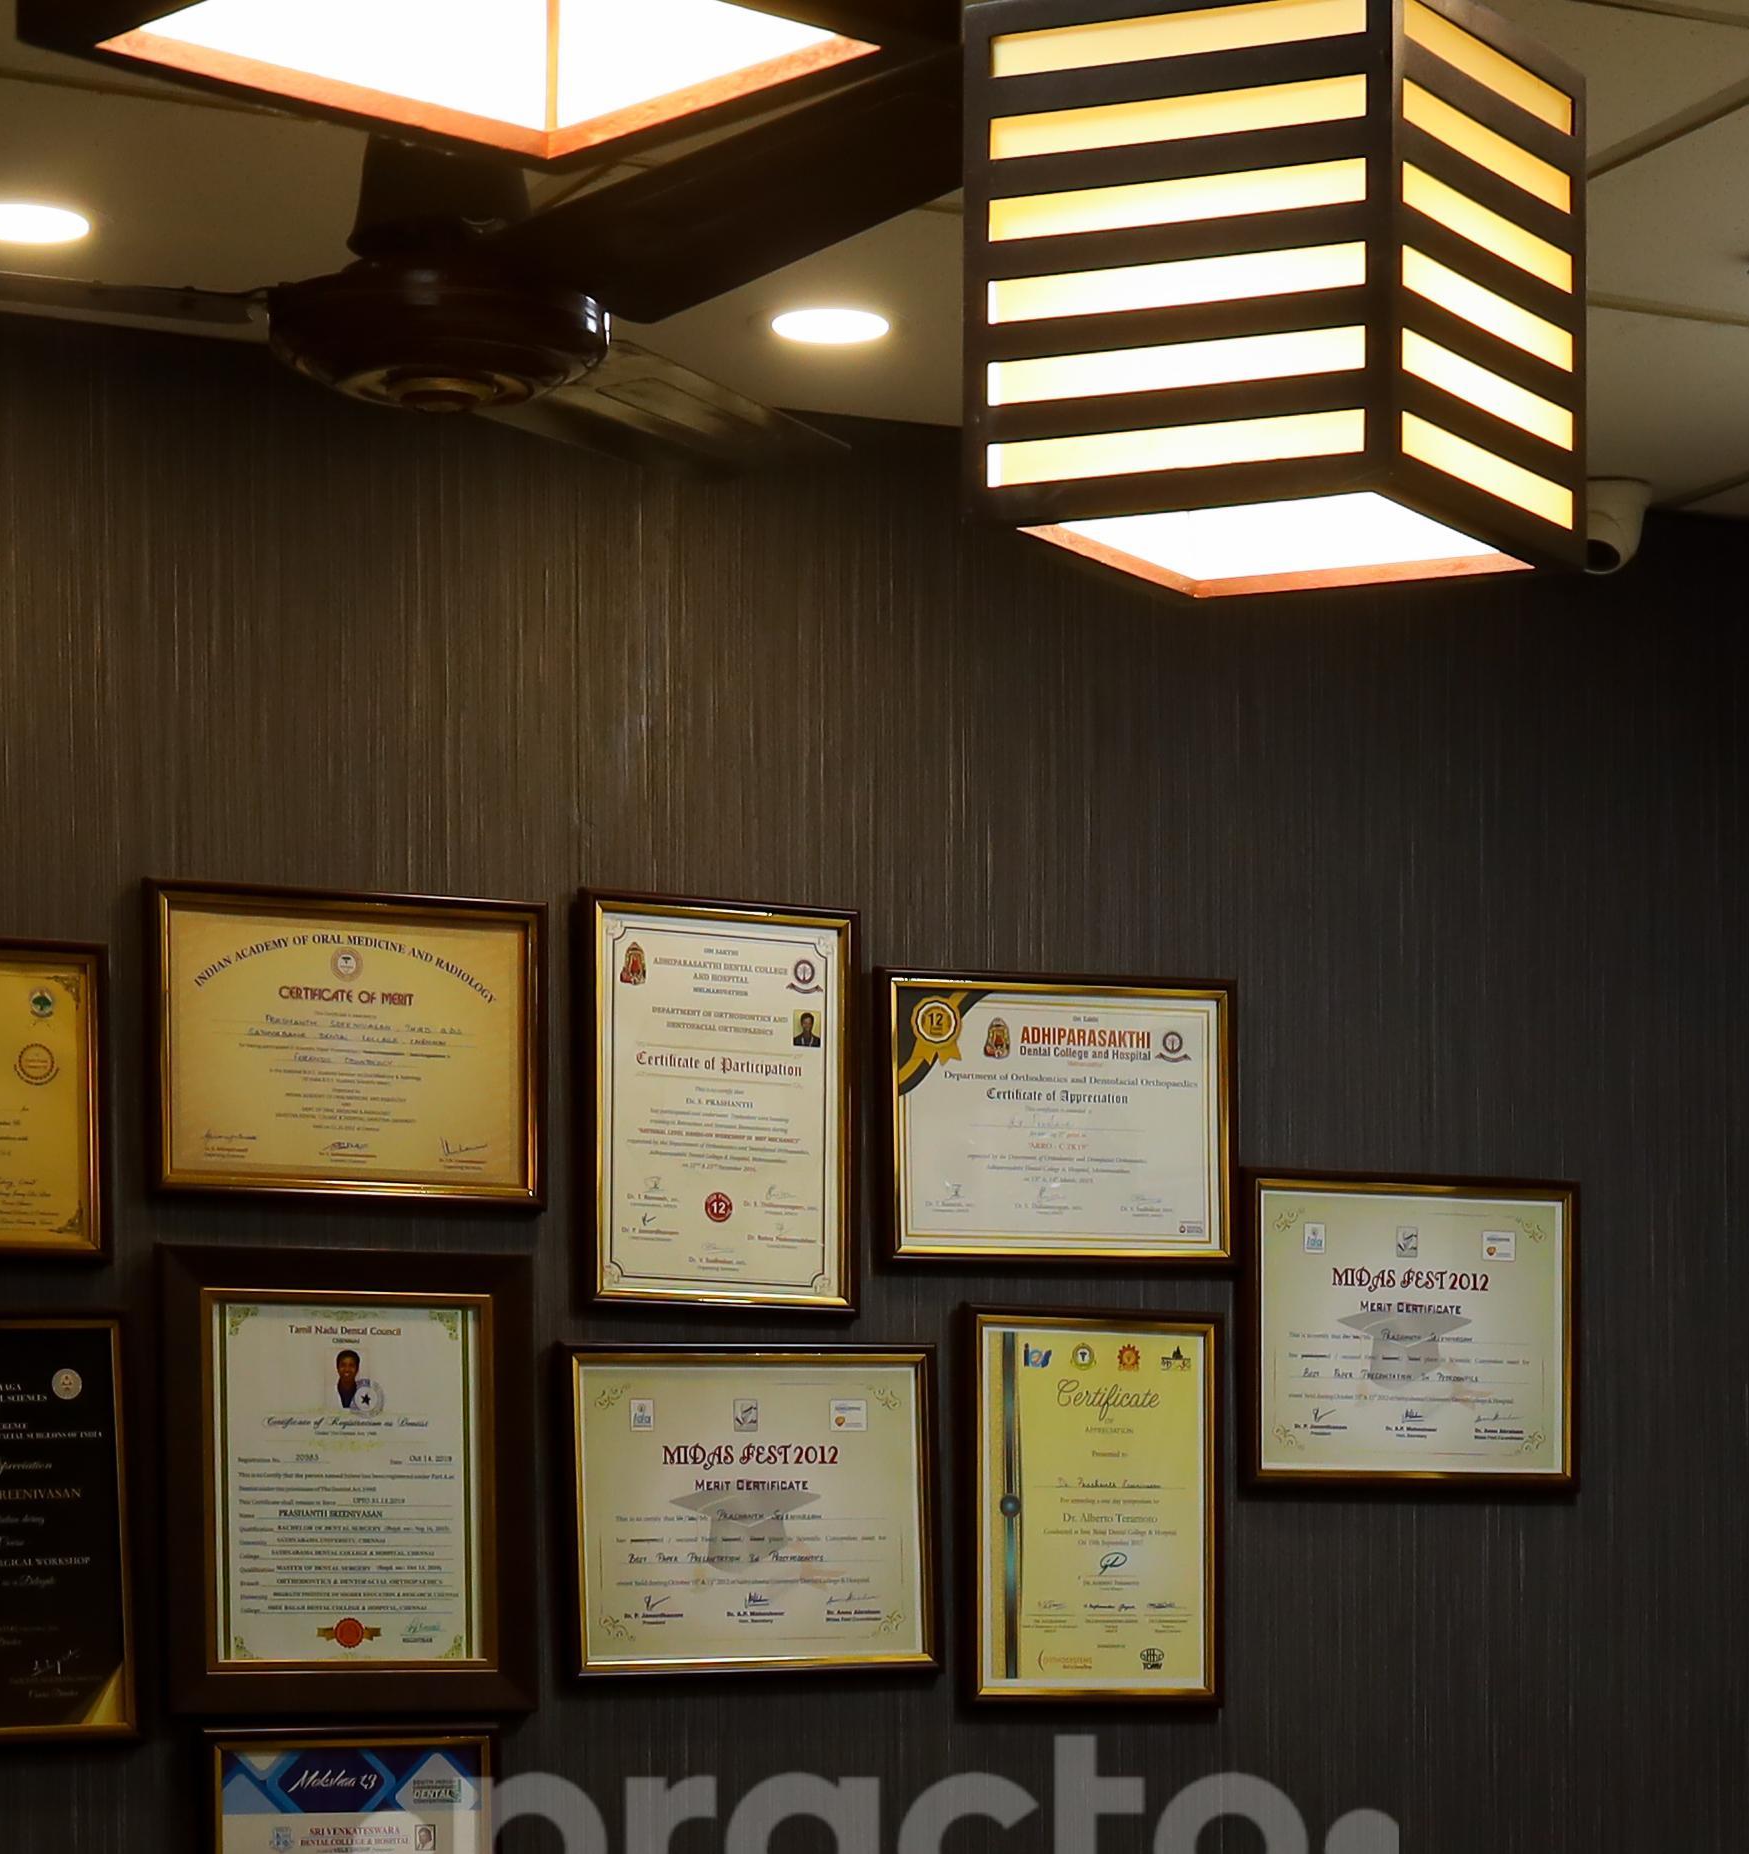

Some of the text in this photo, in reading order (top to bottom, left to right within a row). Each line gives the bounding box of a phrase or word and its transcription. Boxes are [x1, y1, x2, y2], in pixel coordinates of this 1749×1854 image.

[194, 934, 496, 1005] INDIAN ACADEMY OF ORAL MEDICINE AND RADIOLOGY
[278, 986, 414, 1006] CERTIFICATE OF MERIT
[928, 1013, 943, 1026] 12
[1019, 1026, 1151, 1048] ADHIPARASAKTHI
[1019, 1046, 1151, 1062] Dental College and Hospital
[636, 1050, 803, 1079] Certificate of Participation
[1332, 1266, 1490, 1292] MIDAS FEST 2012
[1359, 1300, 1462, 1315] MERIT CERTIFICATE
[288, 1325, 402, 1336] Tamil Nadu Dental Council
[1056, 1378, 1161, 1419] Certificate
[1062, 1511, 1158, 1524] Dr. Alberto Teramoto
